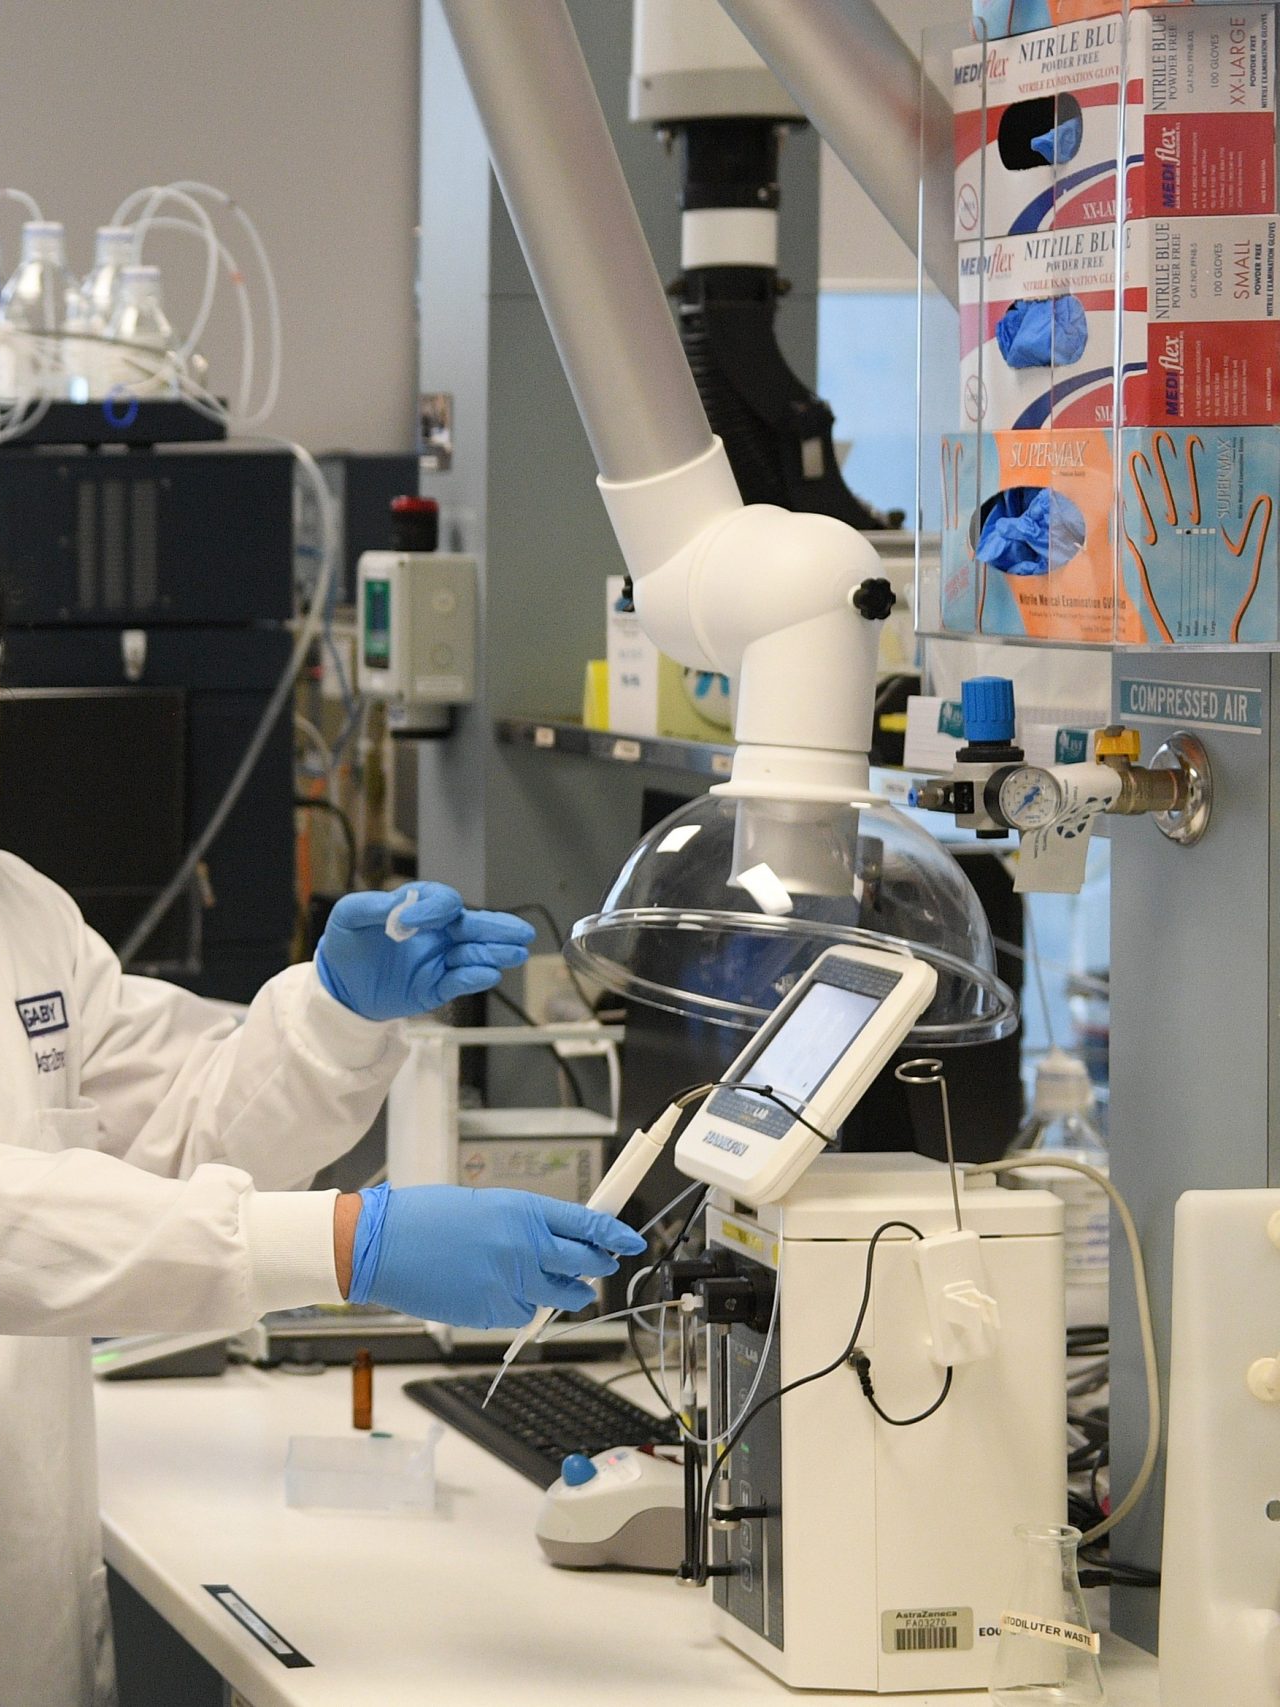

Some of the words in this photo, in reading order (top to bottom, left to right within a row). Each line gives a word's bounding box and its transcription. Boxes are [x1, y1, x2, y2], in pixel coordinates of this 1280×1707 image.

[1151, 14, 1167, 51] BLUE
[1168, 25, 1178, 51] FREE
[1260, 13, 1268, 38] GLOVES
[1018, 30, 1080, 64] NITRLE
[1085, 21, 1131, 49] BLU
[1210, 34, 1219, 70] GLOVES
[1249, 35, 1257, 52] FREE
[1077, 50, 1101, 67] FREE
[1229, 17, 1246, 105] XX-LARGE
[1249, 54, 1257, 87] POWDER
[1151, 55, 1167, 111] NITRILE
[1168, 55, 1178, 100] POWDER
[1210, 72, 1219, 88] 100
[1082, 197, 1133, 219] XX-LAE
[1155, 223, 1170, 260] BLUE
[1171, 233, 1181, 260] FREE
[1267, 222, 1276, 246] GLOVES
[1081, 255, 1105, 269] FREE
[1213, 243, 1223, 278] GLOVES
[1254, 244, 1262, 260] FREE
[1099, 271, 1130, 284] GLOS
[1233, 240, 1251, 300] SMALL
[1254, 262, 1262, 295] POWDER
[1155, 263, 1170, 319] NITRILE
[1171, 263, 1181, 309] POWDER
[1213, 281, 1223, 297] 100
[1095, 404, 1127, 421] SML
[1130, 684, 1218, 720] COMPRESSED
[1223, 693, 1248, 722] AIR
[22, 1001, 56, 1028] GABY
[896, 1610, 957, 1619] AstraZeneca
[1064, 1628, 1092, 1647] WASTE
